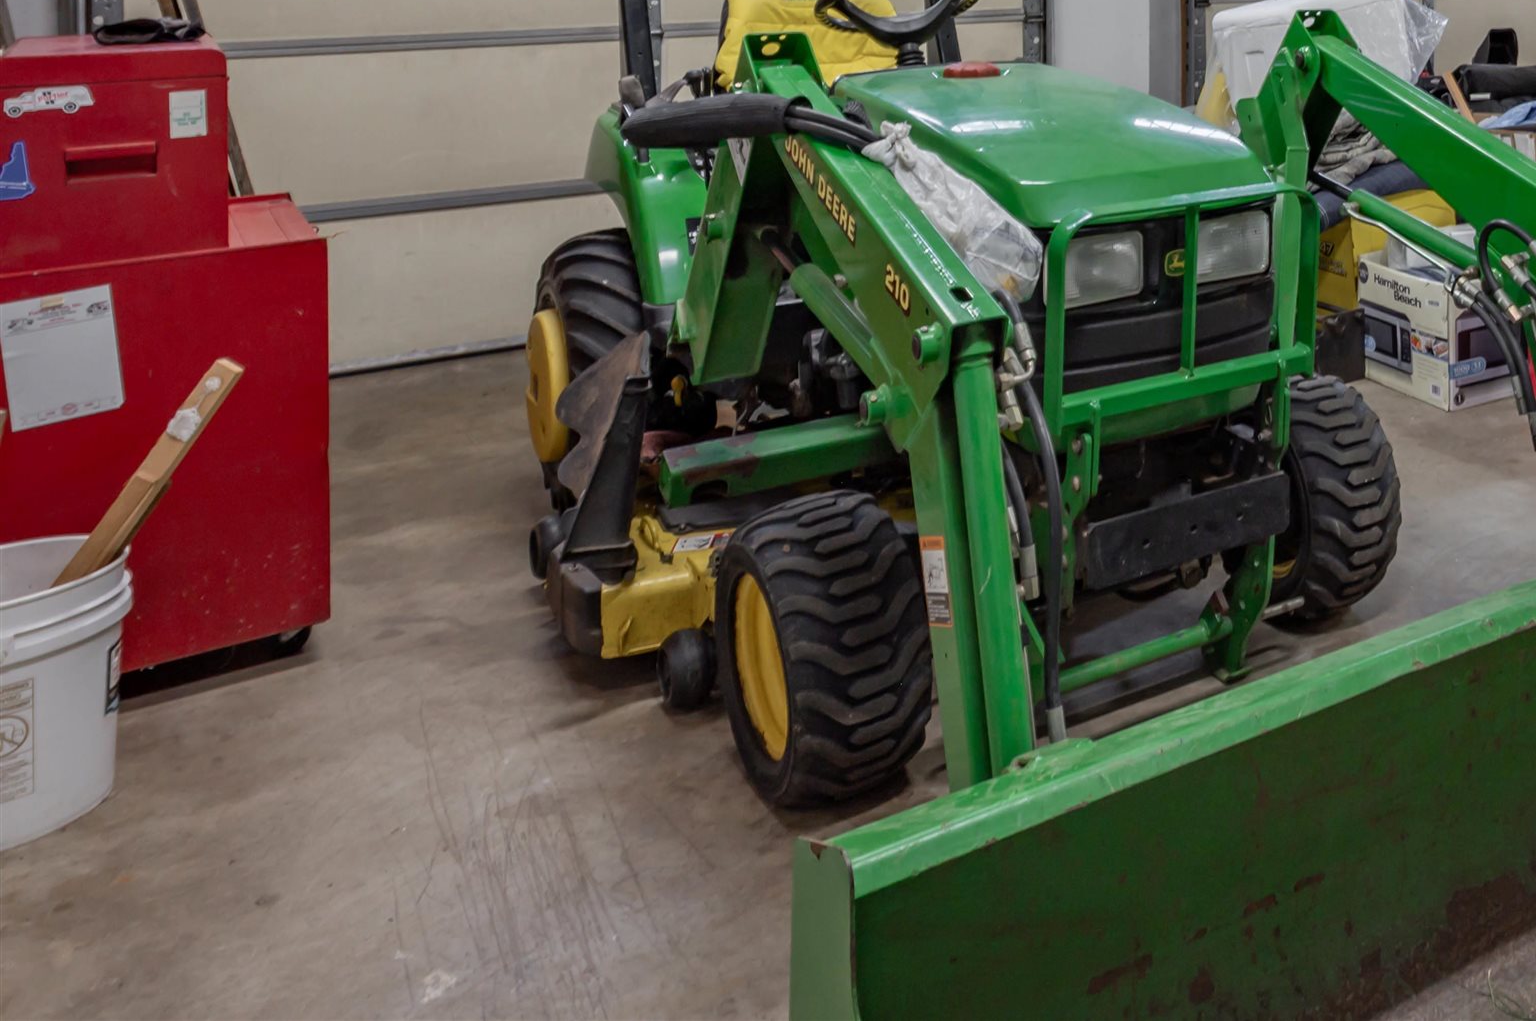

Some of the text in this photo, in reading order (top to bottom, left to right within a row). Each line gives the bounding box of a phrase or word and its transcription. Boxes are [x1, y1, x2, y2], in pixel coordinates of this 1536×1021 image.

[784, 135, 856, 242] JOHN DEERE
[885, 264, 910, 311] 210
[1373, 273, 1411, 295] Hamilton
[1394, 292, 1422, 309] Beach
